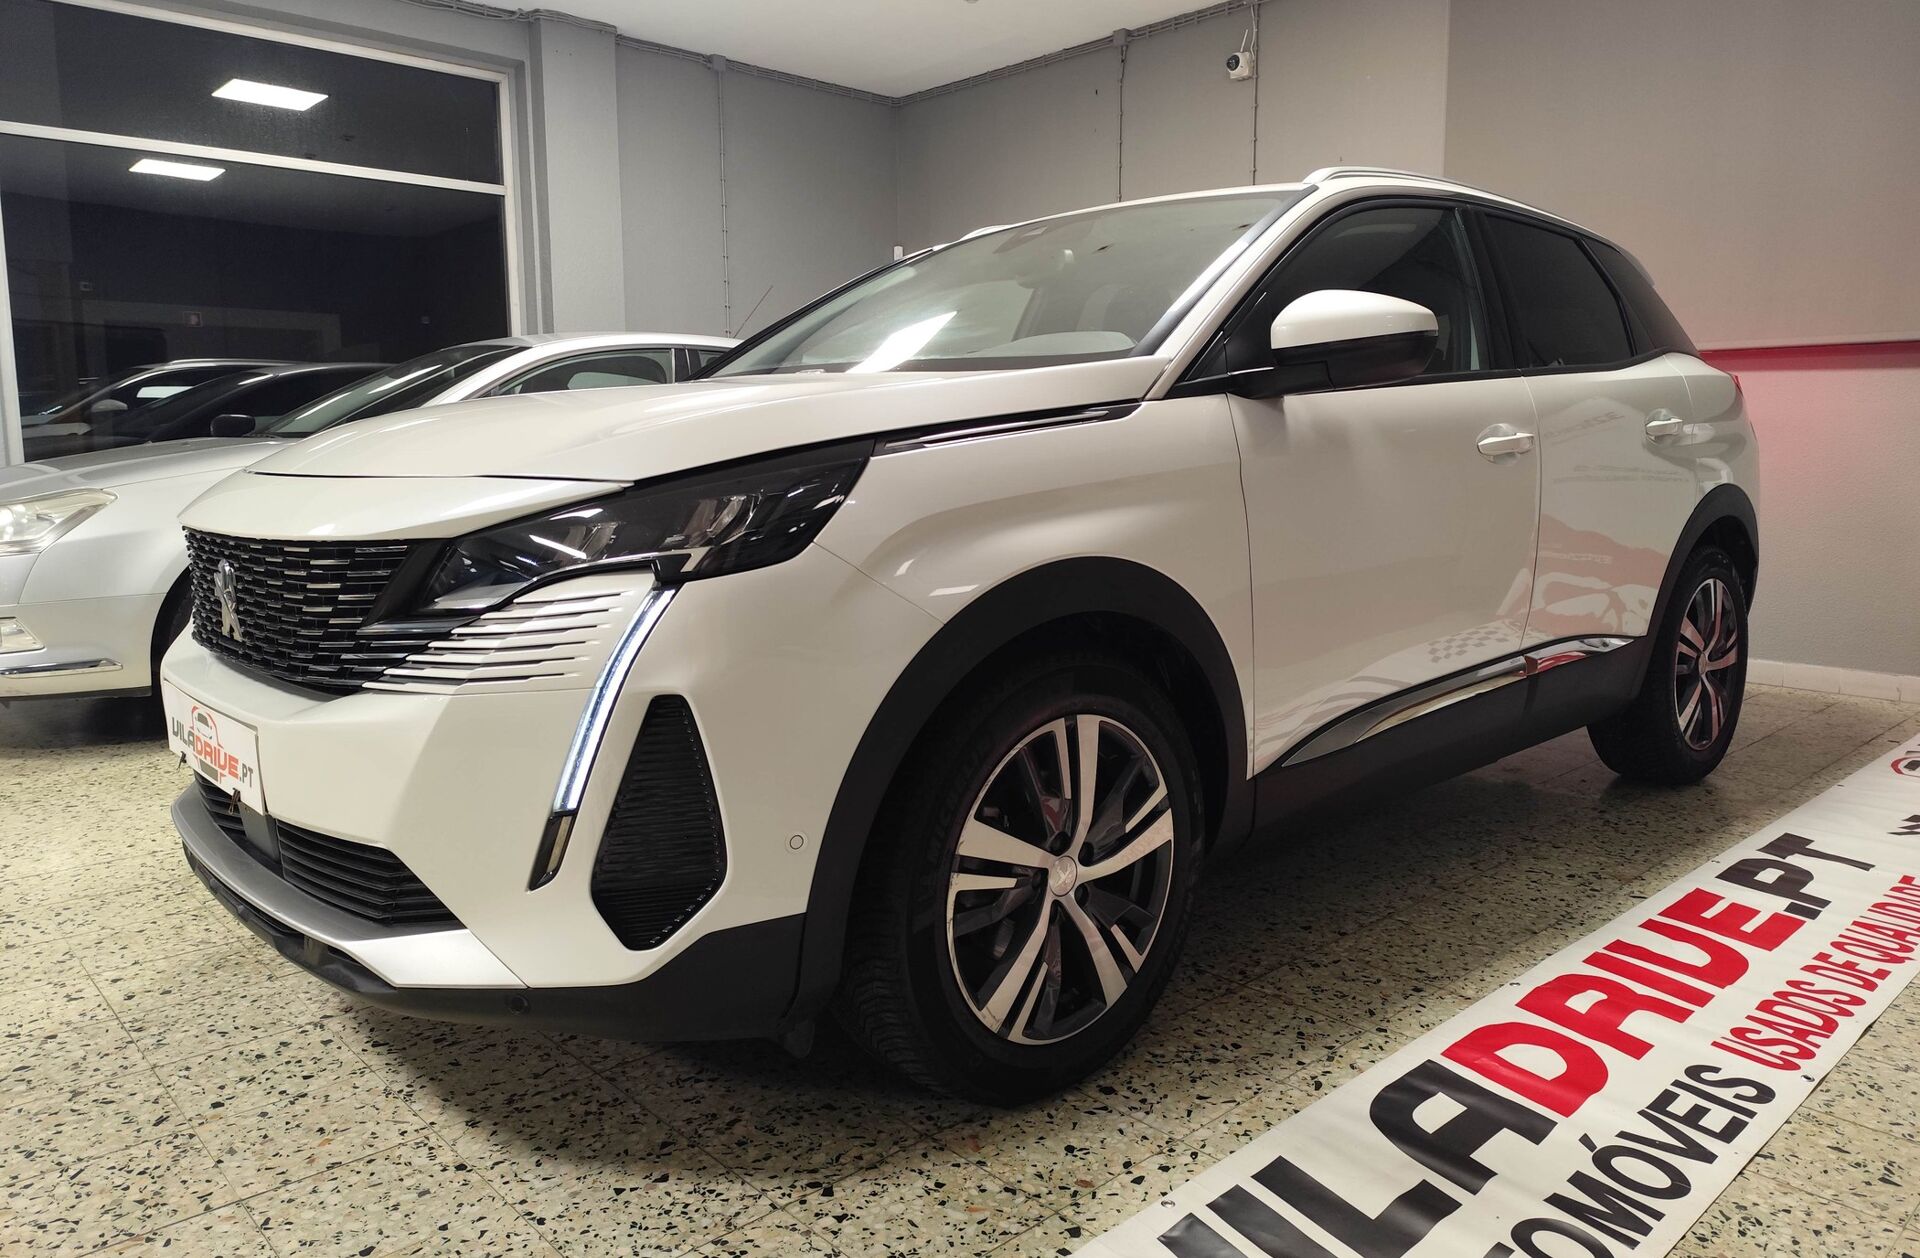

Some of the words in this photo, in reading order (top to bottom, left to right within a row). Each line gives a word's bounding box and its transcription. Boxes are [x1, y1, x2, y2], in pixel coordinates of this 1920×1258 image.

[1157, 832, 1876, 1258] ILADRIVE.PT
[1482, 1064, 1777, 1258] OMÓVEIS
[1710, 979, 1867, 1071] USADOS
[1800, 952, 1892, 992] DE
